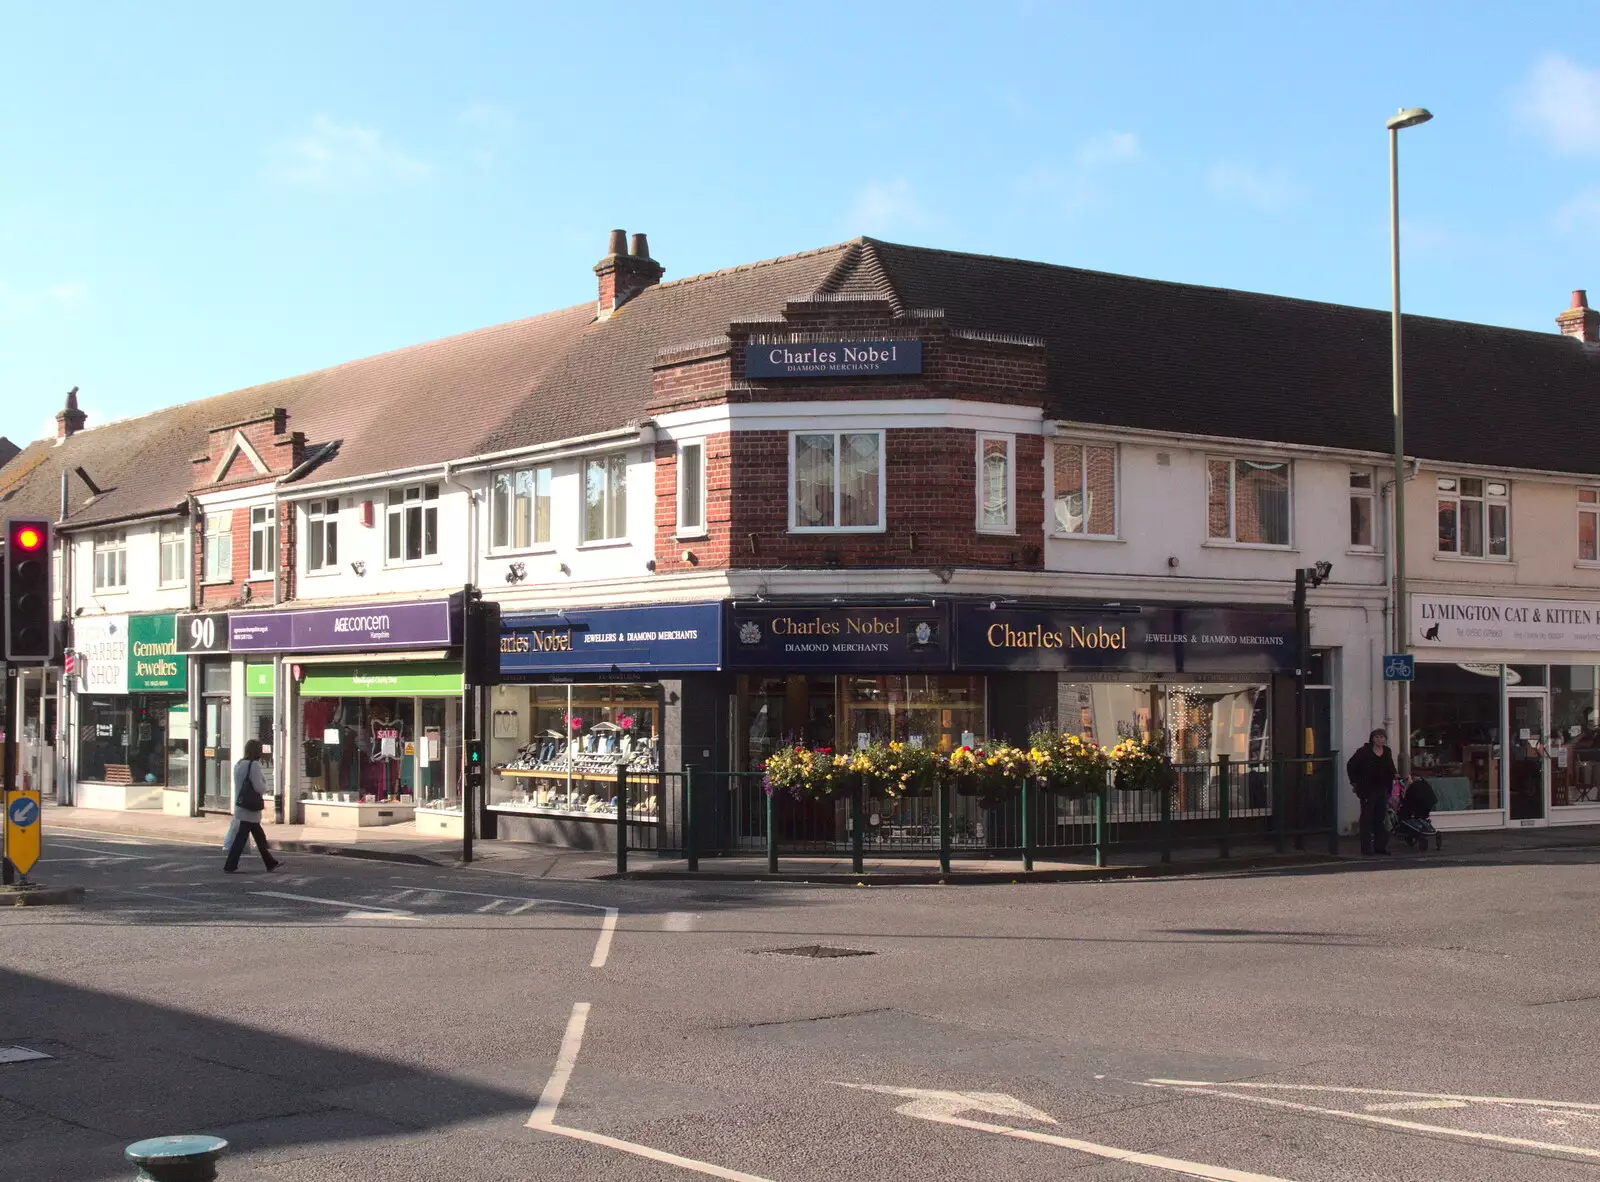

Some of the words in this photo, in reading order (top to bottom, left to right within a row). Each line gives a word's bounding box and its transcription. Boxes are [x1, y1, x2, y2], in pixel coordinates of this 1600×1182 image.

[769, 349, 837, 365] Charles
[843, 346, 897, 363] Nobel
[787, 364, 827, 372] DIAMOND
[829, 363, 880, 371] MERCHANTS
[1421, 603, 1500, 622] LYMINGTON
[1504, 606, 1529, 623] CAT
[1532, 608, 1541, 623] &
[1546, 608, 1591, 625] KITTEN
[190, 617, 215, 649] 90
[771, 617, 840, 635] Charles
[846, 617, 900, 635] Nobel
[500, 630, 529, 653] arles
[531, 628, 573, 652] Nobel
[583, 632, 617, 643] JEWELLERS
[618, 632, 625, 642] &
[626, 631, 657, 642] DIAMOND
[658, 630, 698, 641] MERCHANTS
[987, 623, 1063, 649] Charles
[1069, 625, 1126, 649] Nobel
[1144, 633, 1188, 643] JEWELLERS
[1190, 634, 1198, 643] &
[1201, 634, 1237, 644] DIAMOND
[1239, 635, 1284, 645] MERCHANTS
[85, 641, 125, 661] BARBER
[785, 643, 829, 652] DIAMOND
[832, 643, 889, 652] MERCHANTS
[91, 665, 120, 685] SHOP
[135, 658, 177, 677] Jewellers
[377, 730, 398, 739] SALE
